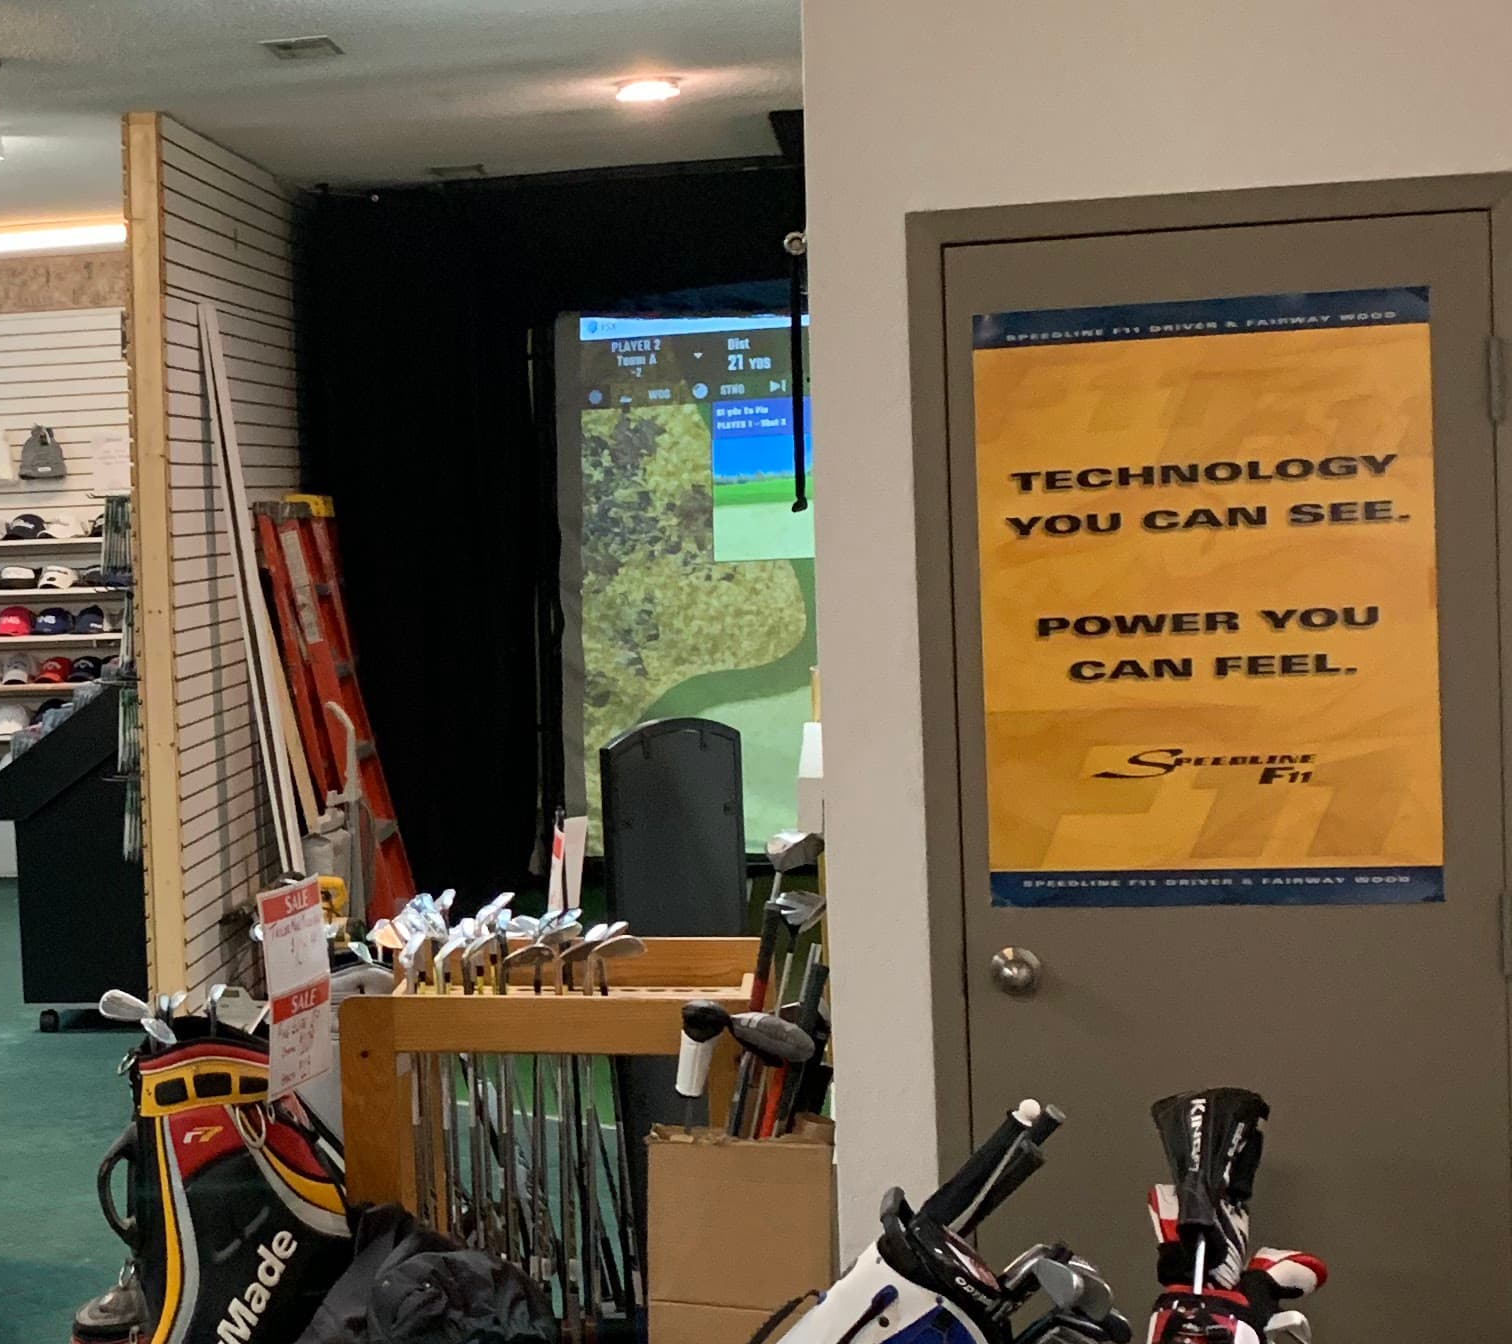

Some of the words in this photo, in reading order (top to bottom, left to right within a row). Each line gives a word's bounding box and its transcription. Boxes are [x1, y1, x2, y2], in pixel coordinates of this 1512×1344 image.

[610, 339, 653, 354] PLAYER
[653, 338, 662, 352] 2
[727, 337, 751, 351] Dist
[1009, 453, 1399, 494] TECHNOLOGY
[1005, 512, 1123, 538] YOU
[1142, 505, 1268, 533] CAN
[1288, 499, 1412, 526] SEE.
[1036, 609, 1241, 639] POWER
[1260, 605, 1380, 632] YOU
[1067, 657, 1194, 682] CAN
[1214, 653, 1359, 679] FEEL.
[284, 889, 310, 914] SALE
[290, 987, 319, 1014] SALE
